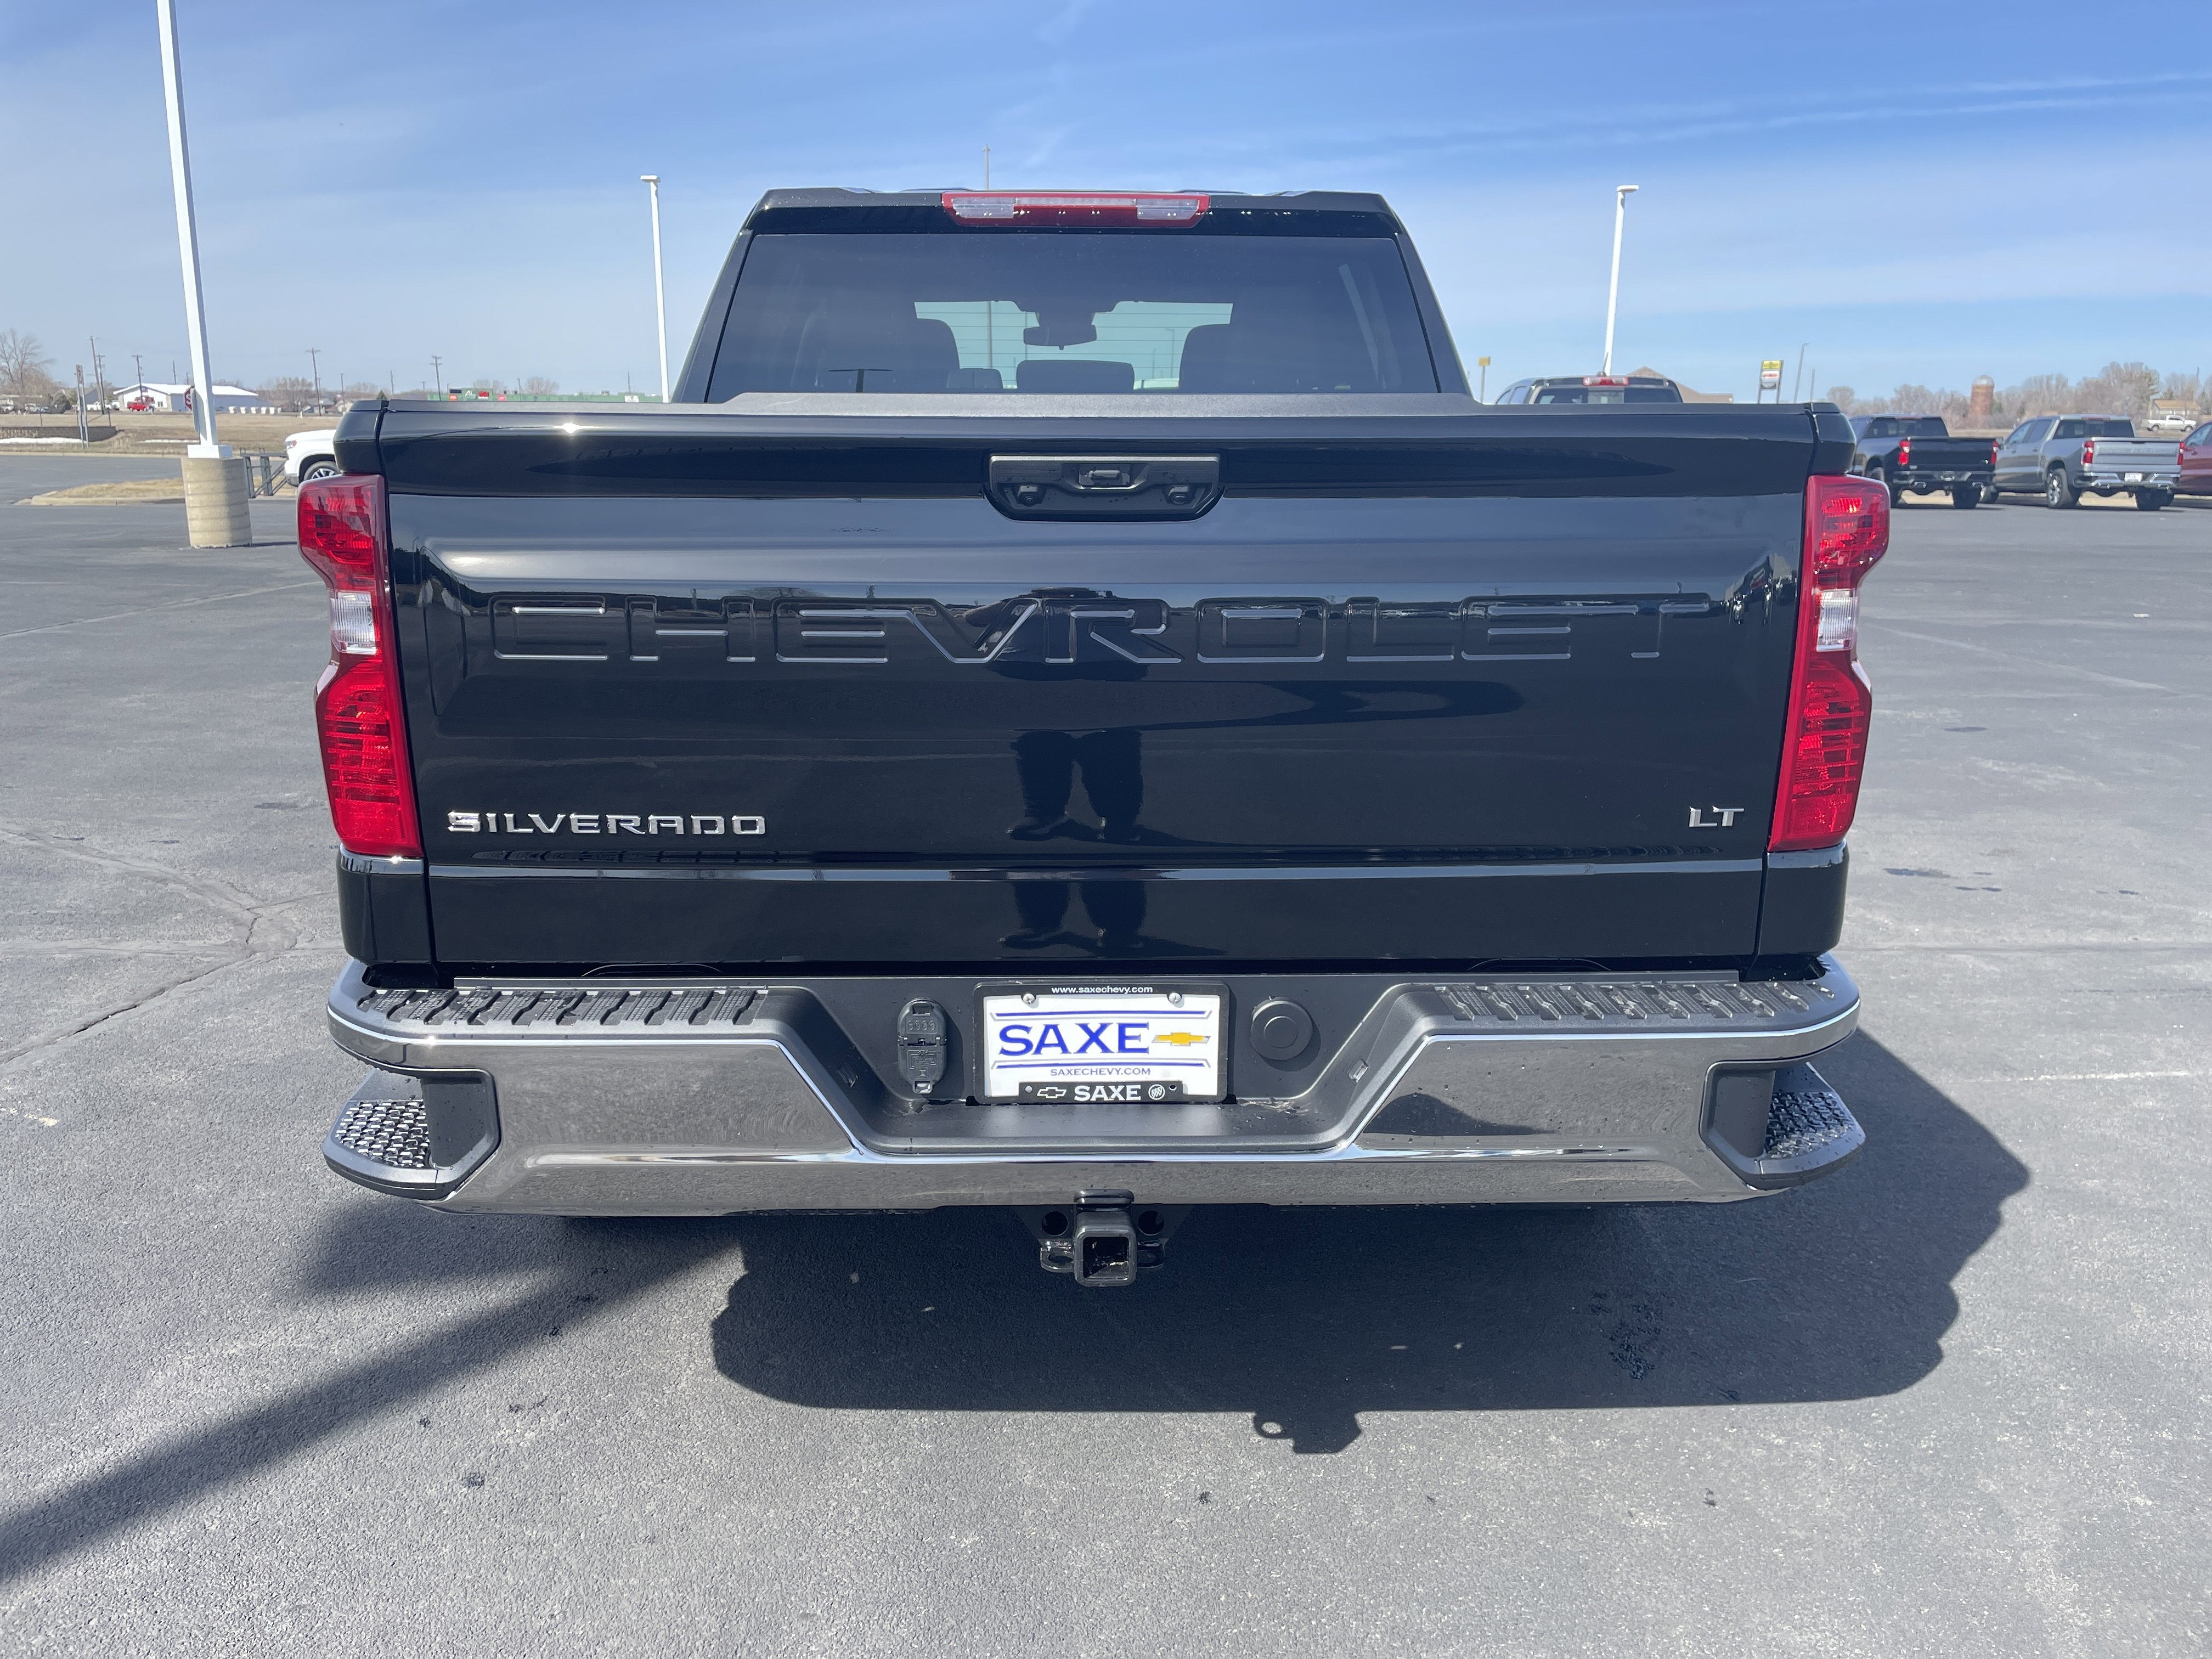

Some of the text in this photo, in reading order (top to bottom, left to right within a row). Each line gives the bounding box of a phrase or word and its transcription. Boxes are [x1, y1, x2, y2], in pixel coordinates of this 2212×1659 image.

[488, 592, 1711, 662] CHEVROLET
[447, 811, 766, 835] SILVERADO
[1689, 807, 1745, 827] LT
[1051, 985, 1153, 995] www.saxechevy.com
[998, 1022, 1150, 1057] SAXE
[1049, 1068, 1151, 1076] SAXECHEVY.COM
[1074, 1084, 1141, 1102] SAXE
